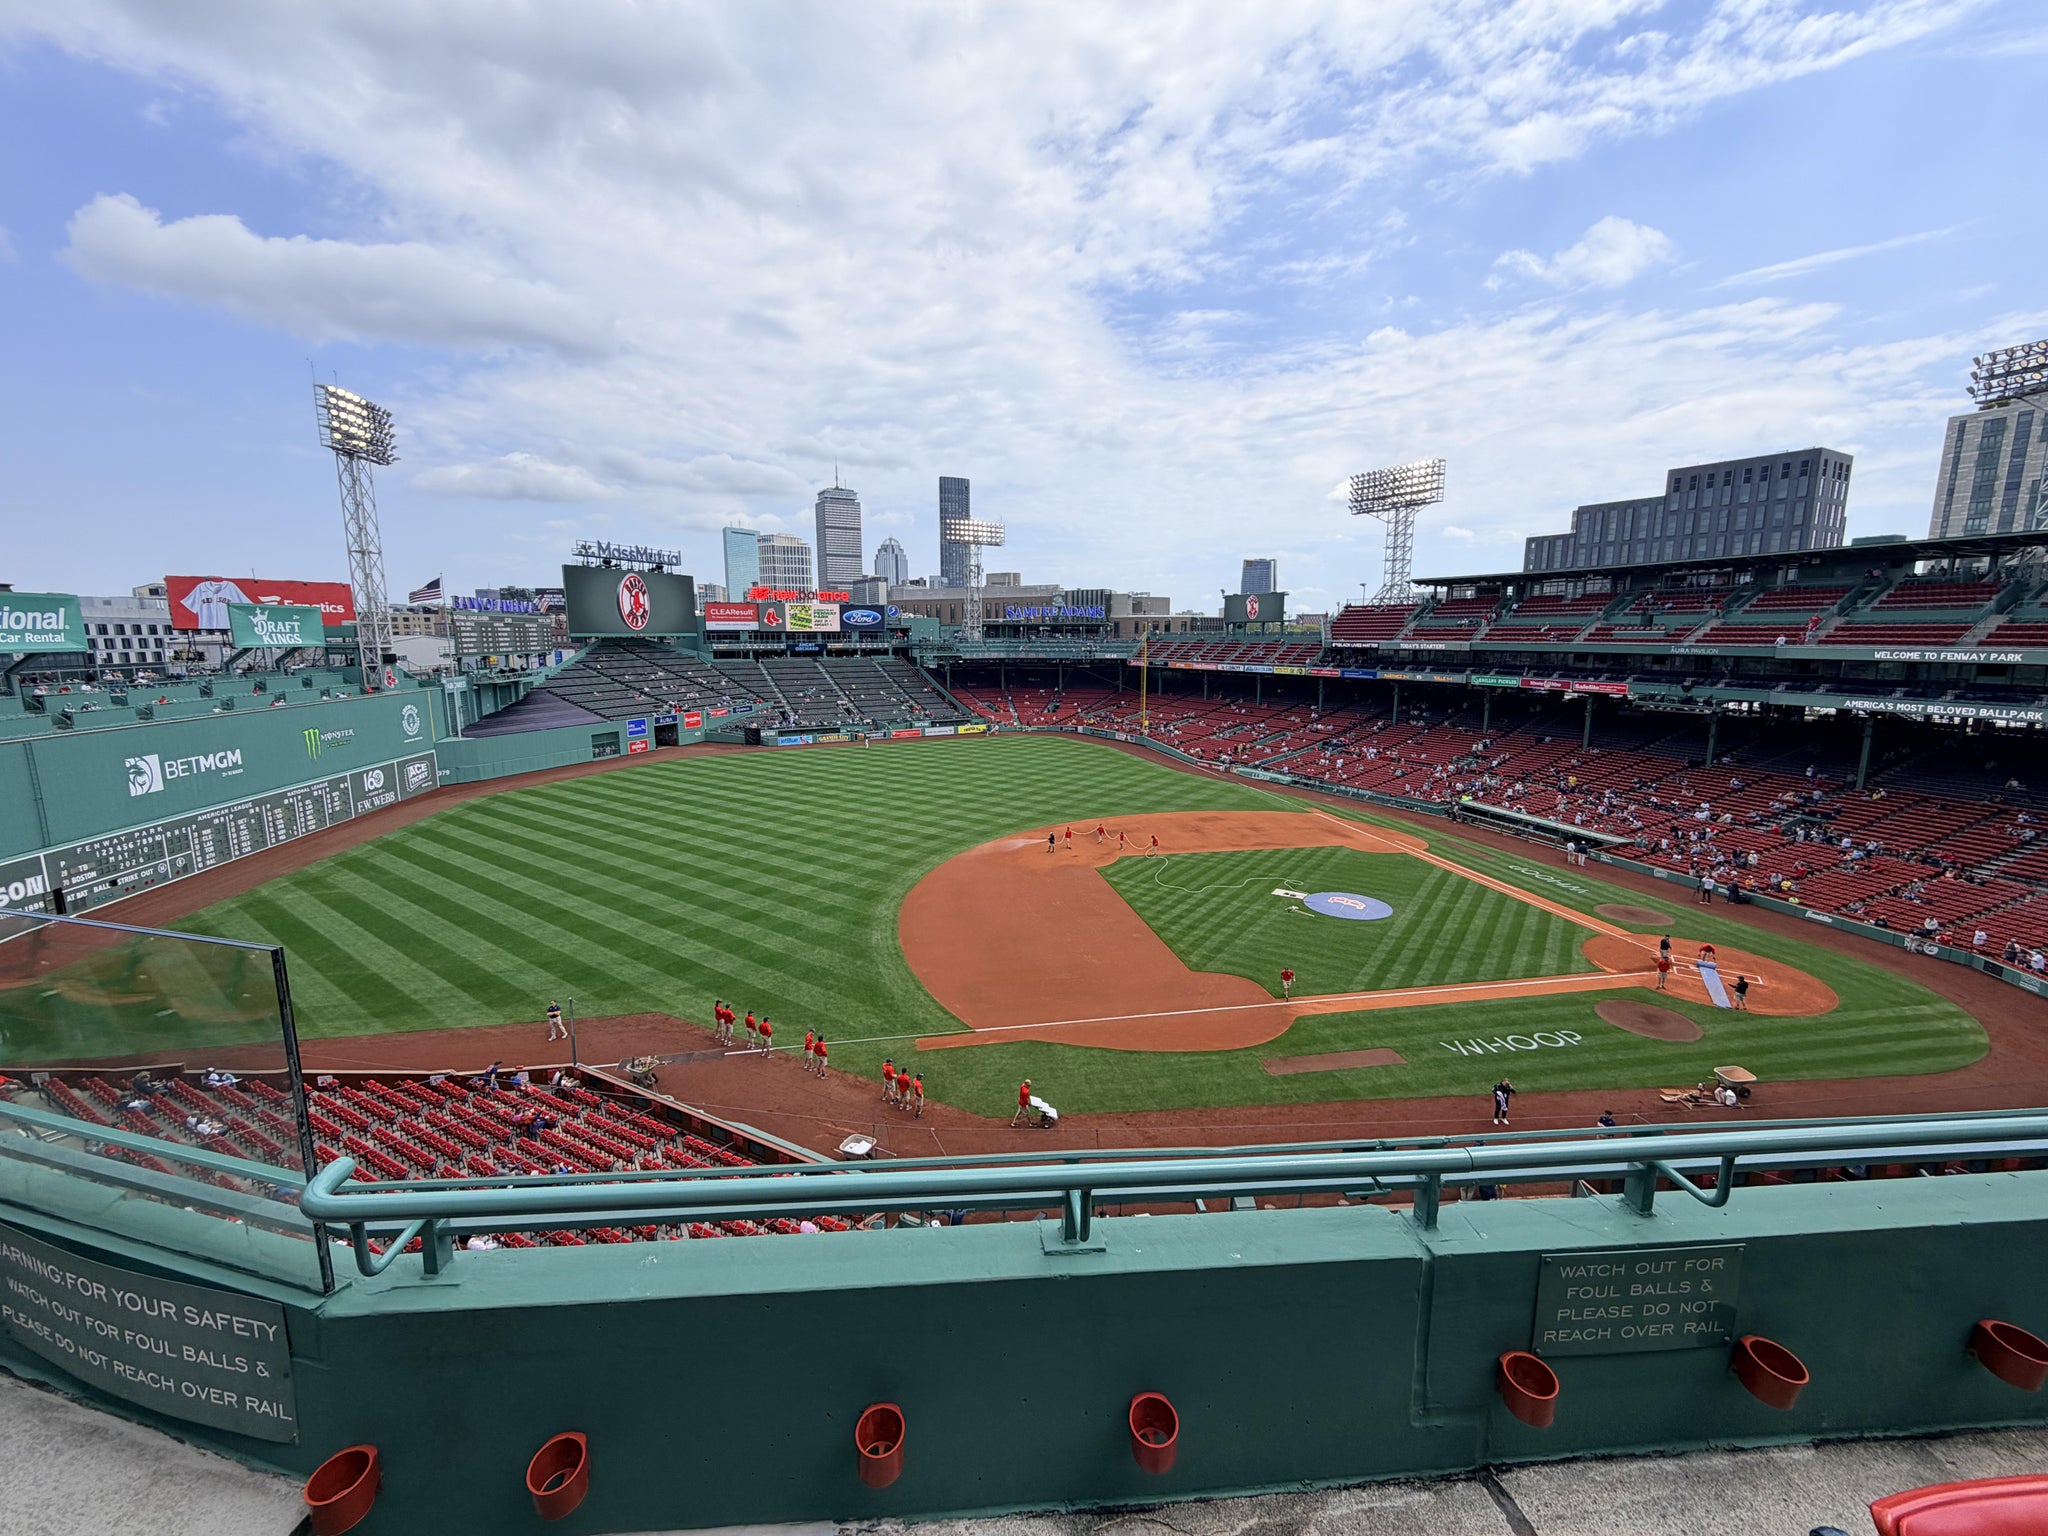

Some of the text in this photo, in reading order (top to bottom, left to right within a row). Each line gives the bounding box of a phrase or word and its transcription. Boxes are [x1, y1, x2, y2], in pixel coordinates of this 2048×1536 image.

[597, 540, 681, 566] MassMutual
[453, 596, 482, 611] BANK
[772, 588, 850, 602] new balance
[710, 608, 754, 616] CLEAResult
[850, 611, 874, 623] Ford
[1060, 604, 1105, 619] ADAMS
[254, 620, 300, 636] DRAFT
[0, 632, 65, 643] Car Rental
[262, 633, 303, 645] KINGS
[1874, 651, 2022, 661] WELCOME TO FENWAY PARK
[1843, 700, 2043, 720] AMERICA'S MOST BELOVED BALLPARK
[164, 748, 242, 780] BETMGM
[407, 763, 428, 777] ACE
[411, 771, 429, 785] TICKET
[373, 792, 396, 806] WEBB
[197, 802, 253, 821] AMERICAN LEAGUE
[76, 826, 163, 855] FENWAY PARK
[78, 863, 89, 872] TB
[71, 870, 97, 884] BOSTON
[76, 889, 89, 899] BAT
[93, 882, 111, 893] BALL
[117, 872, 139, 886] STRIKE
[140, 868, 154, 878] OUT
[1439, 1030, 1583, 1056] WHOOP
[1560, 1257, 1725, 1279] WATCH OUT FOR
[1566, 1278, 1713, 1300] FOUL BALLS &
[65, 1271, 108, 1303] FOR
[111, 1288, 178, 1321] YOUR
[183, 1305, 278, 1342] SAFETY
[1557, 1300, 1719, 1321] PLEASE DO NOT
[6, 1276, 270, 1378] WATCH OUT FOR FOUL BALLS &
[1543, 1320, 1725, 1343] REACH OVER RAIL
[2, 1304, 293, 1421] PLEASE DO NOT REACH OVER RAIL
